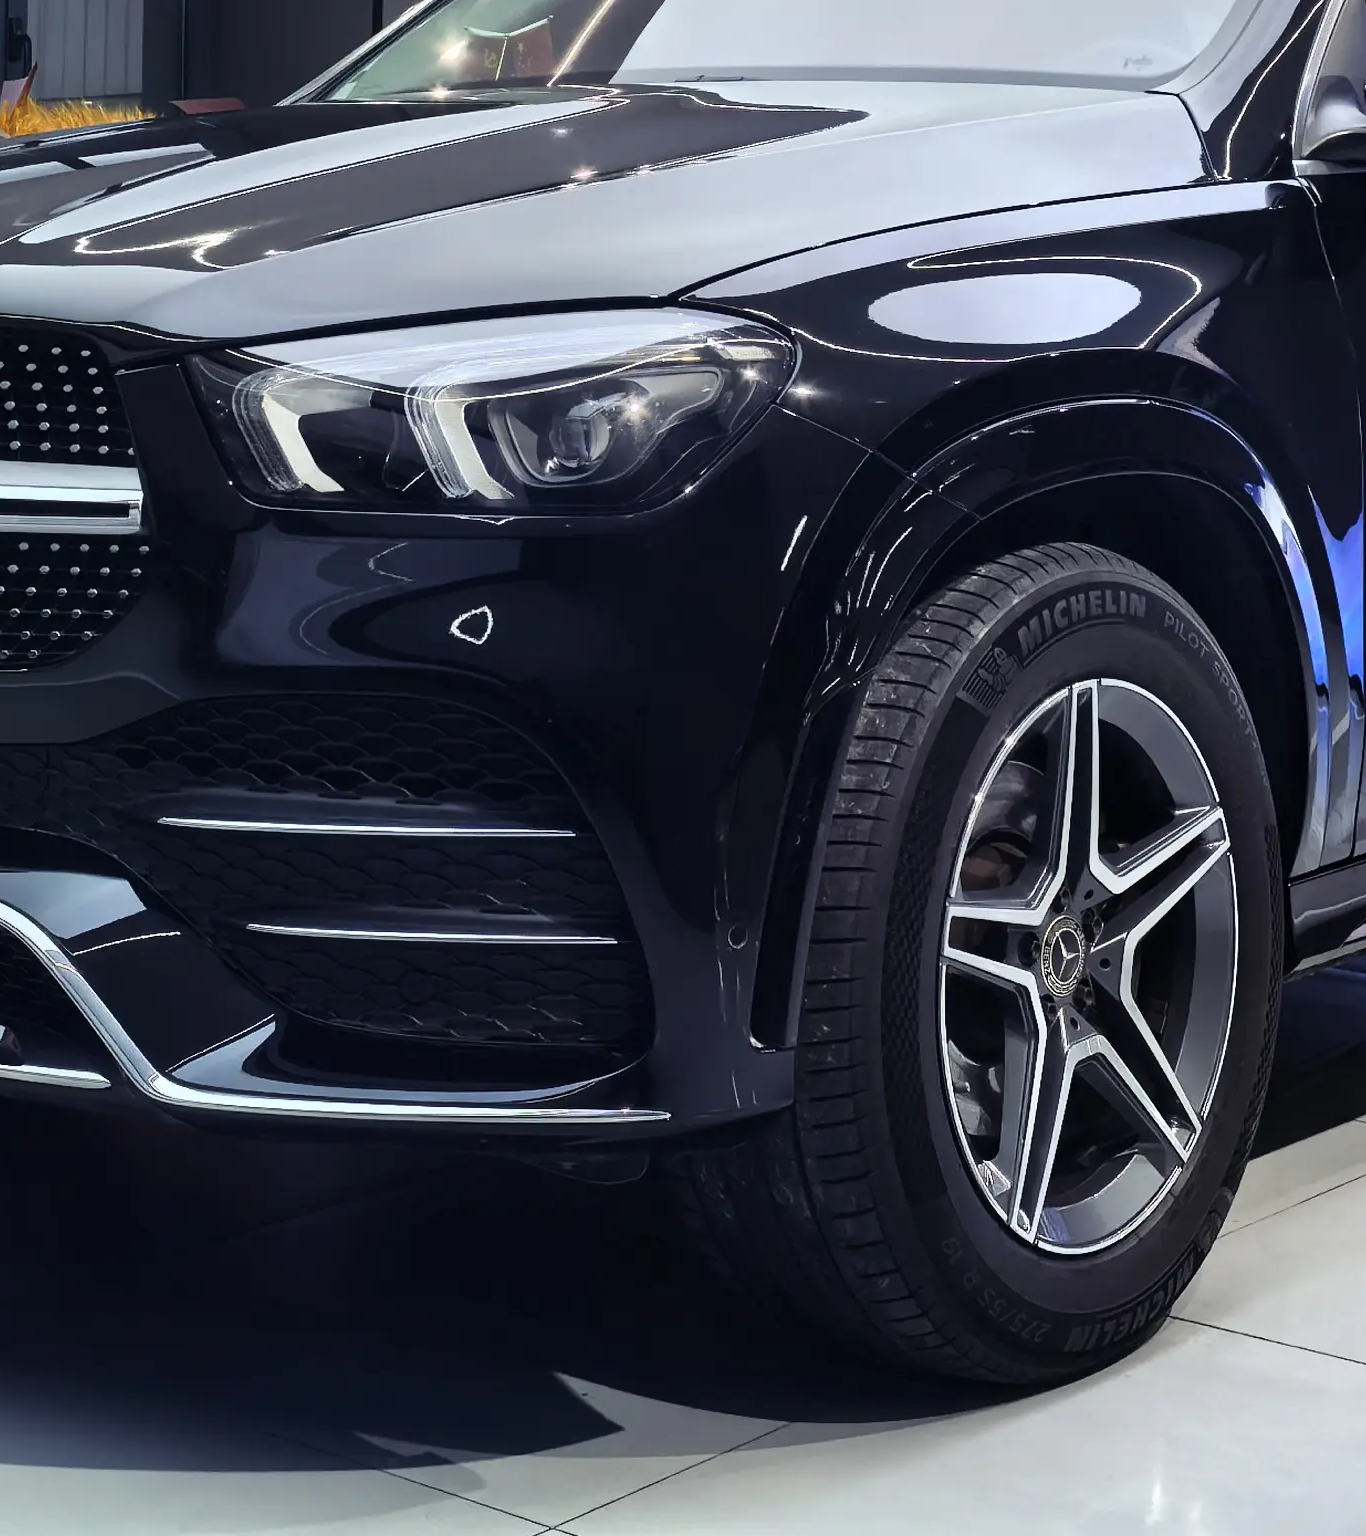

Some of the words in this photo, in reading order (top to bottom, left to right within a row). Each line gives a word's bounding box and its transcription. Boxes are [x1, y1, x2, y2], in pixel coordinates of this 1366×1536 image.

[1017, 589, 1147, 657] MICHELIN
[1163, 611, 1211, 660] PILOT
[1211, 661, 1254, 738] SPORT
[1063, 1249, 1196, 1353] MICHELIN
